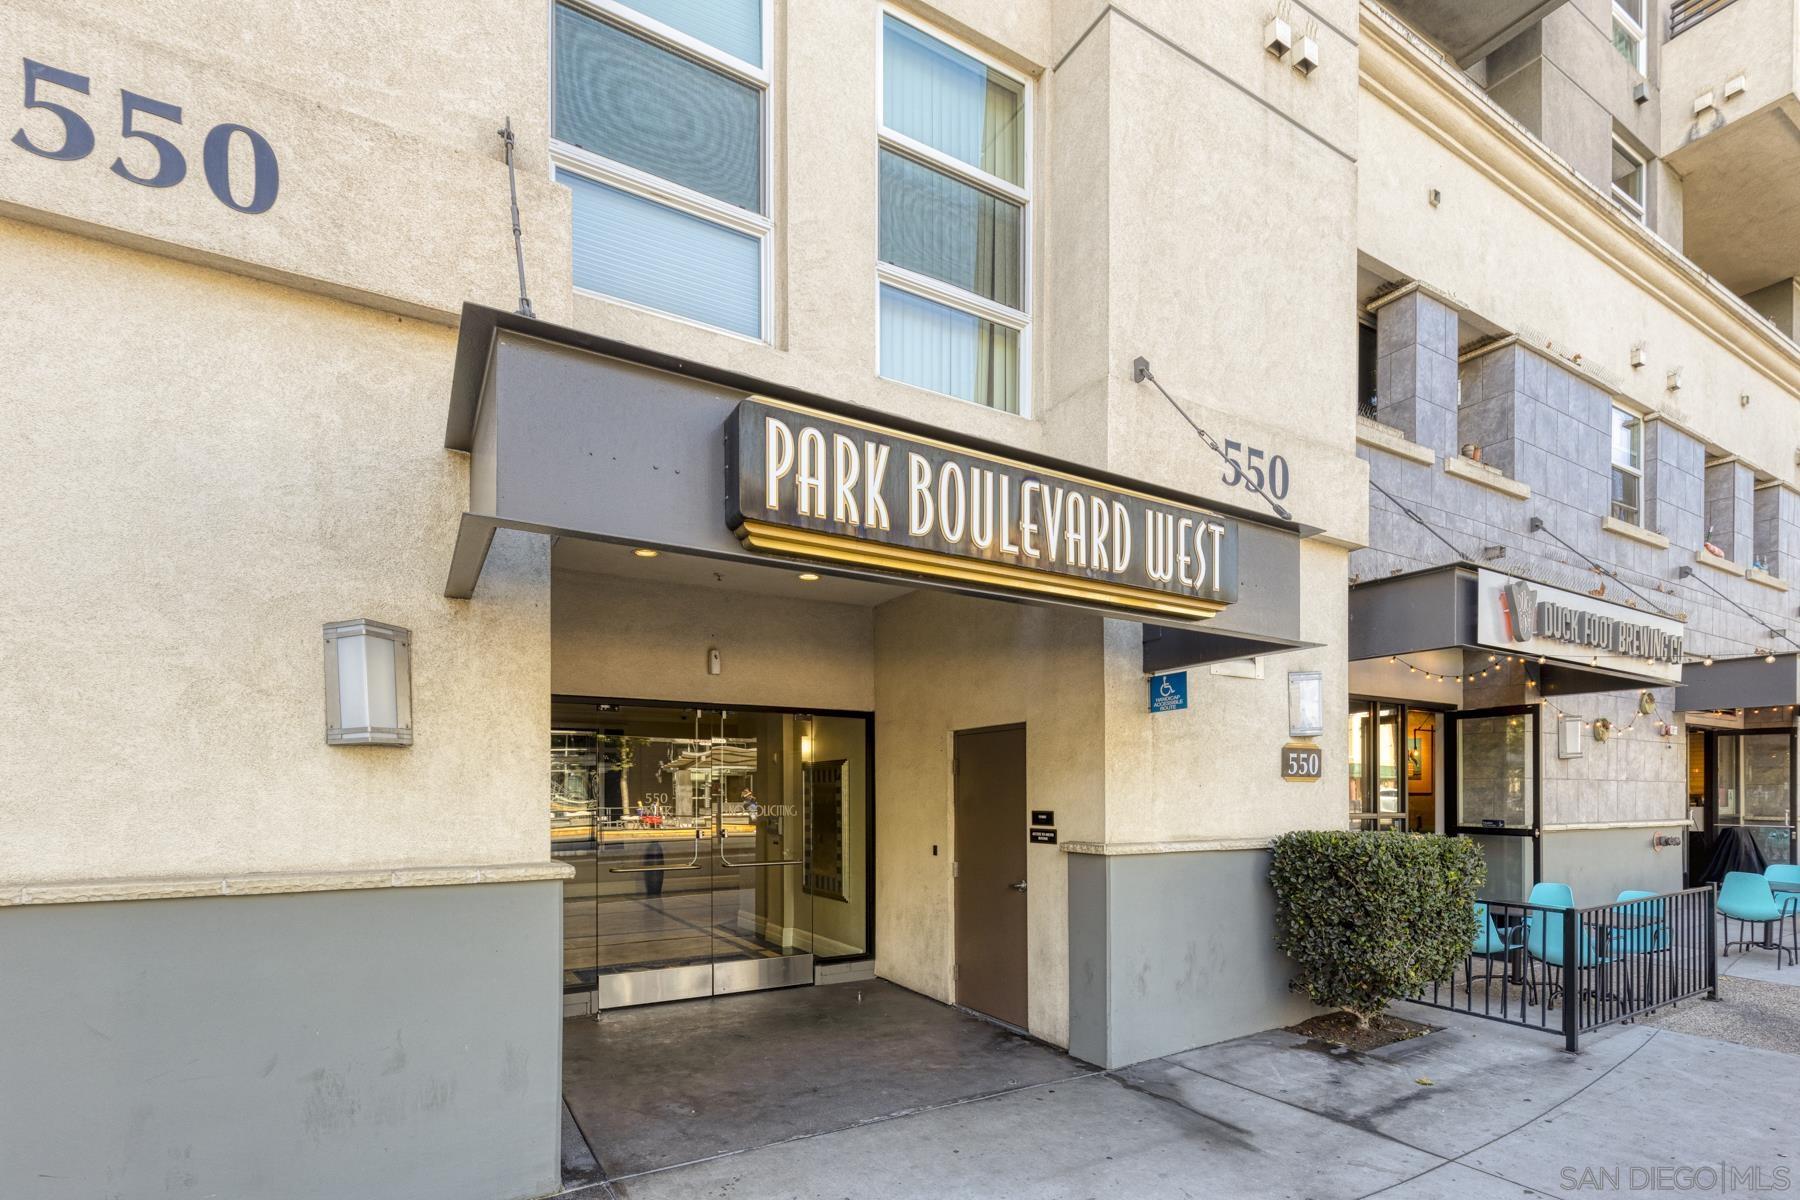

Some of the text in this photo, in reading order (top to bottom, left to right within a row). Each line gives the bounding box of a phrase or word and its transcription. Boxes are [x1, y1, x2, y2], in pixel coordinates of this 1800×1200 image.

[11, 57, 280, 214] 550
[1221, 438, 1290, 501] 550
[764, 415, 1226, 593] PARK BOULEVARD WEST
[1543, 601, 1581, 644] DUCK
[1584, 610, 1615, 651] FOOT
[1618, 620, 1669, 661] BREWING
[1288, 753, 1319, 775] 550
[645, 792, 668, 804] 550
[751, 804, 798, 817] OLICITING
